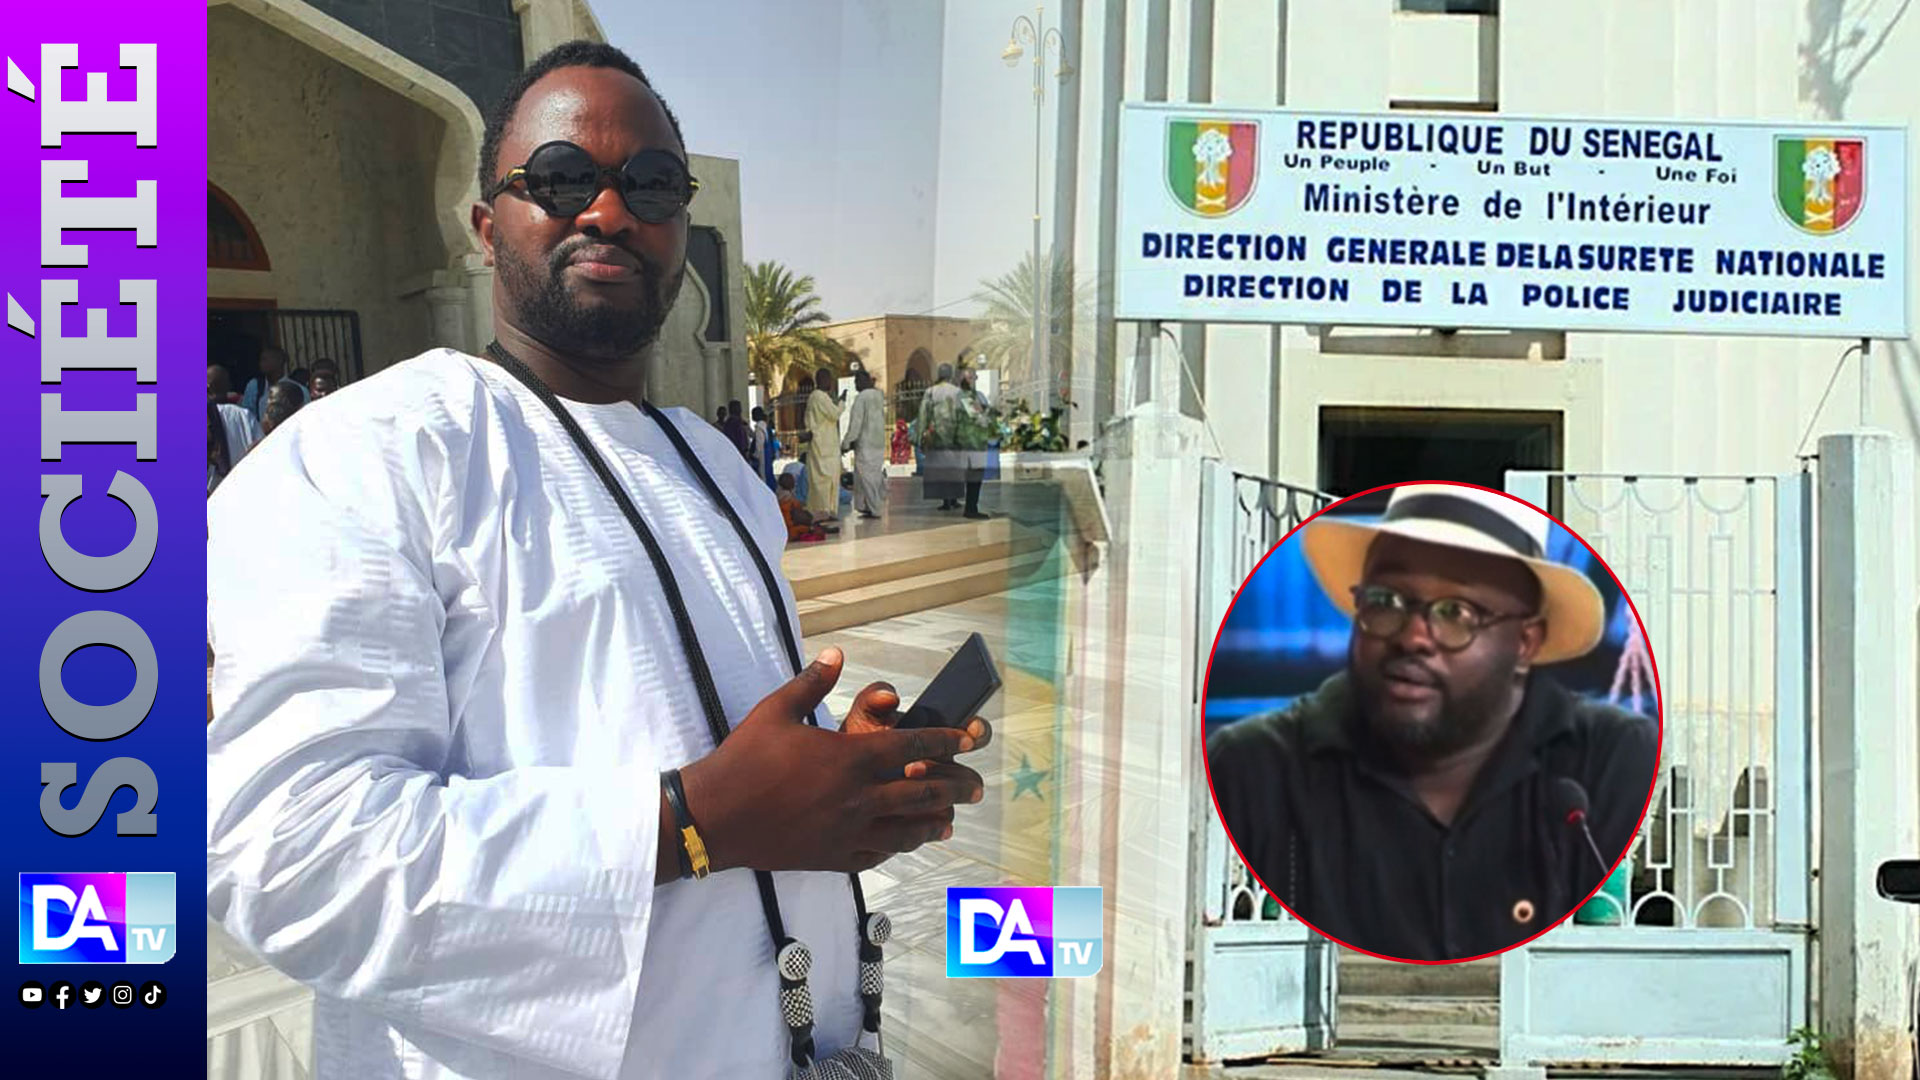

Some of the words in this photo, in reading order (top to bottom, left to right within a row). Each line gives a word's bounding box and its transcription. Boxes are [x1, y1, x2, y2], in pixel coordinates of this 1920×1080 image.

[1297, 120, 1503, 155] REPUBLIQUE
[1530, 127, 1571, 156] DU
[1583, 128, 1723, 162] SENEGAL
[1284, 154, 1311, 168] Un
[1320, 155, 1390, 172] Peuple
[1477, 160, 1505, 175] Un
[1514, 162, 1551, 177] But
[1656, 167, 1697, 182] Une
[1706, 168, 1737, 184] Foi
[1304, 183, 1459, 216] Ministère
[1483, 190, 1522, 220] de
[1548, 192, 1710, 225] l'Intérieur
[1142, 233, 1306, 261] DIRECTION
[1326, 237, 1486, 266] GENERALE
[1716, 249, 1885, 279] NATIONALE
[1184, 275, 1348, 301] DIRECTION
[1382, 280, 1422, 302] DE
[1452, 282, 1488, 305] LA
[1523, 284, 1629, 310] POLICE
[1673, 289, 1842, 316] JUDICIAIRE
